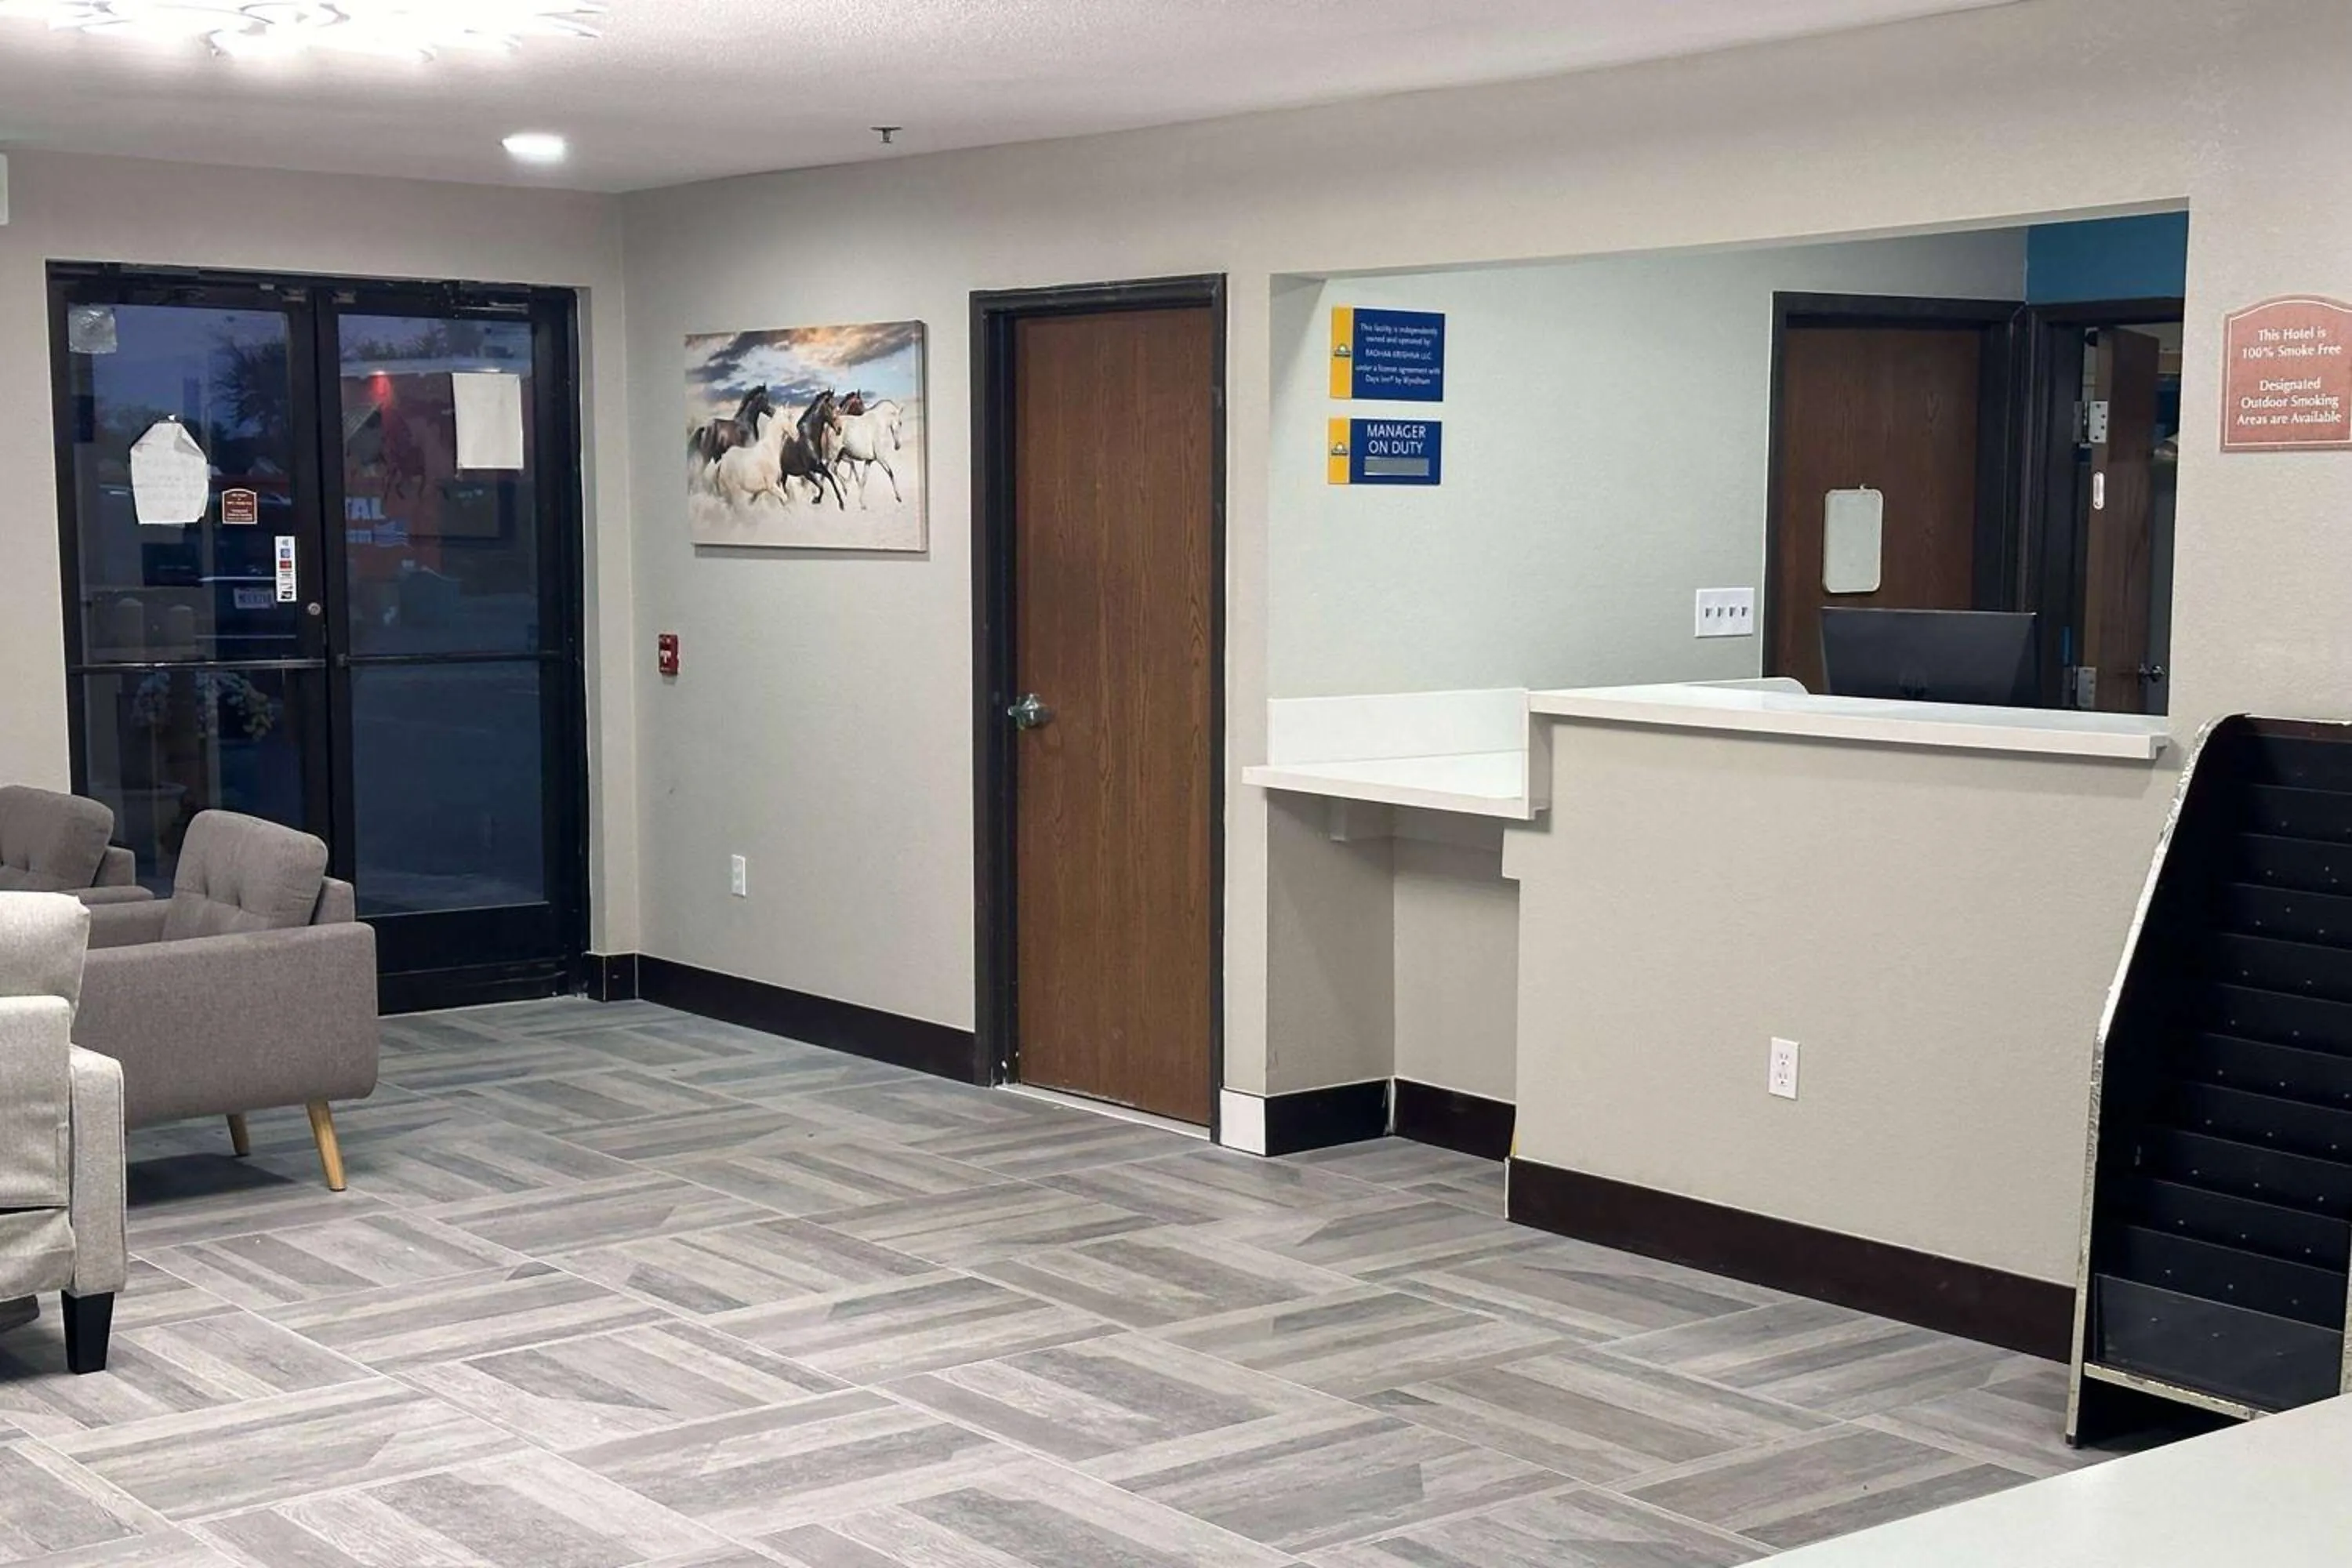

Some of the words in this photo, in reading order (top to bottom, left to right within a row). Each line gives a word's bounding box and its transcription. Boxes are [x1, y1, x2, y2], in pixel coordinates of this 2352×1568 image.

[2258, 329, 2280, 342] This
[2283, 326, 2314, 340] Hotel
[2317, 326, 2327, 338] is
[2242, 347, 2274, 359] 100%
[2278, 346, 2315, 358] Smoke
[2318, 343, 2342, 356] Free
[2259, 377, 2321, 394] Designated
[2241, 396, 2288, 408] Outdoor
[2291, 394, 2339, 408] Smoking
[2237, 414, 2267, 425] Areas
[2270, 415, 2287, 424] are
[2291, 412, 2342, 424] Available
[1367, 424, 1427, 438] MANAGER
[1368, 441, 1388, 454] ON
[1392, 441, 1424, 455] DUTY
